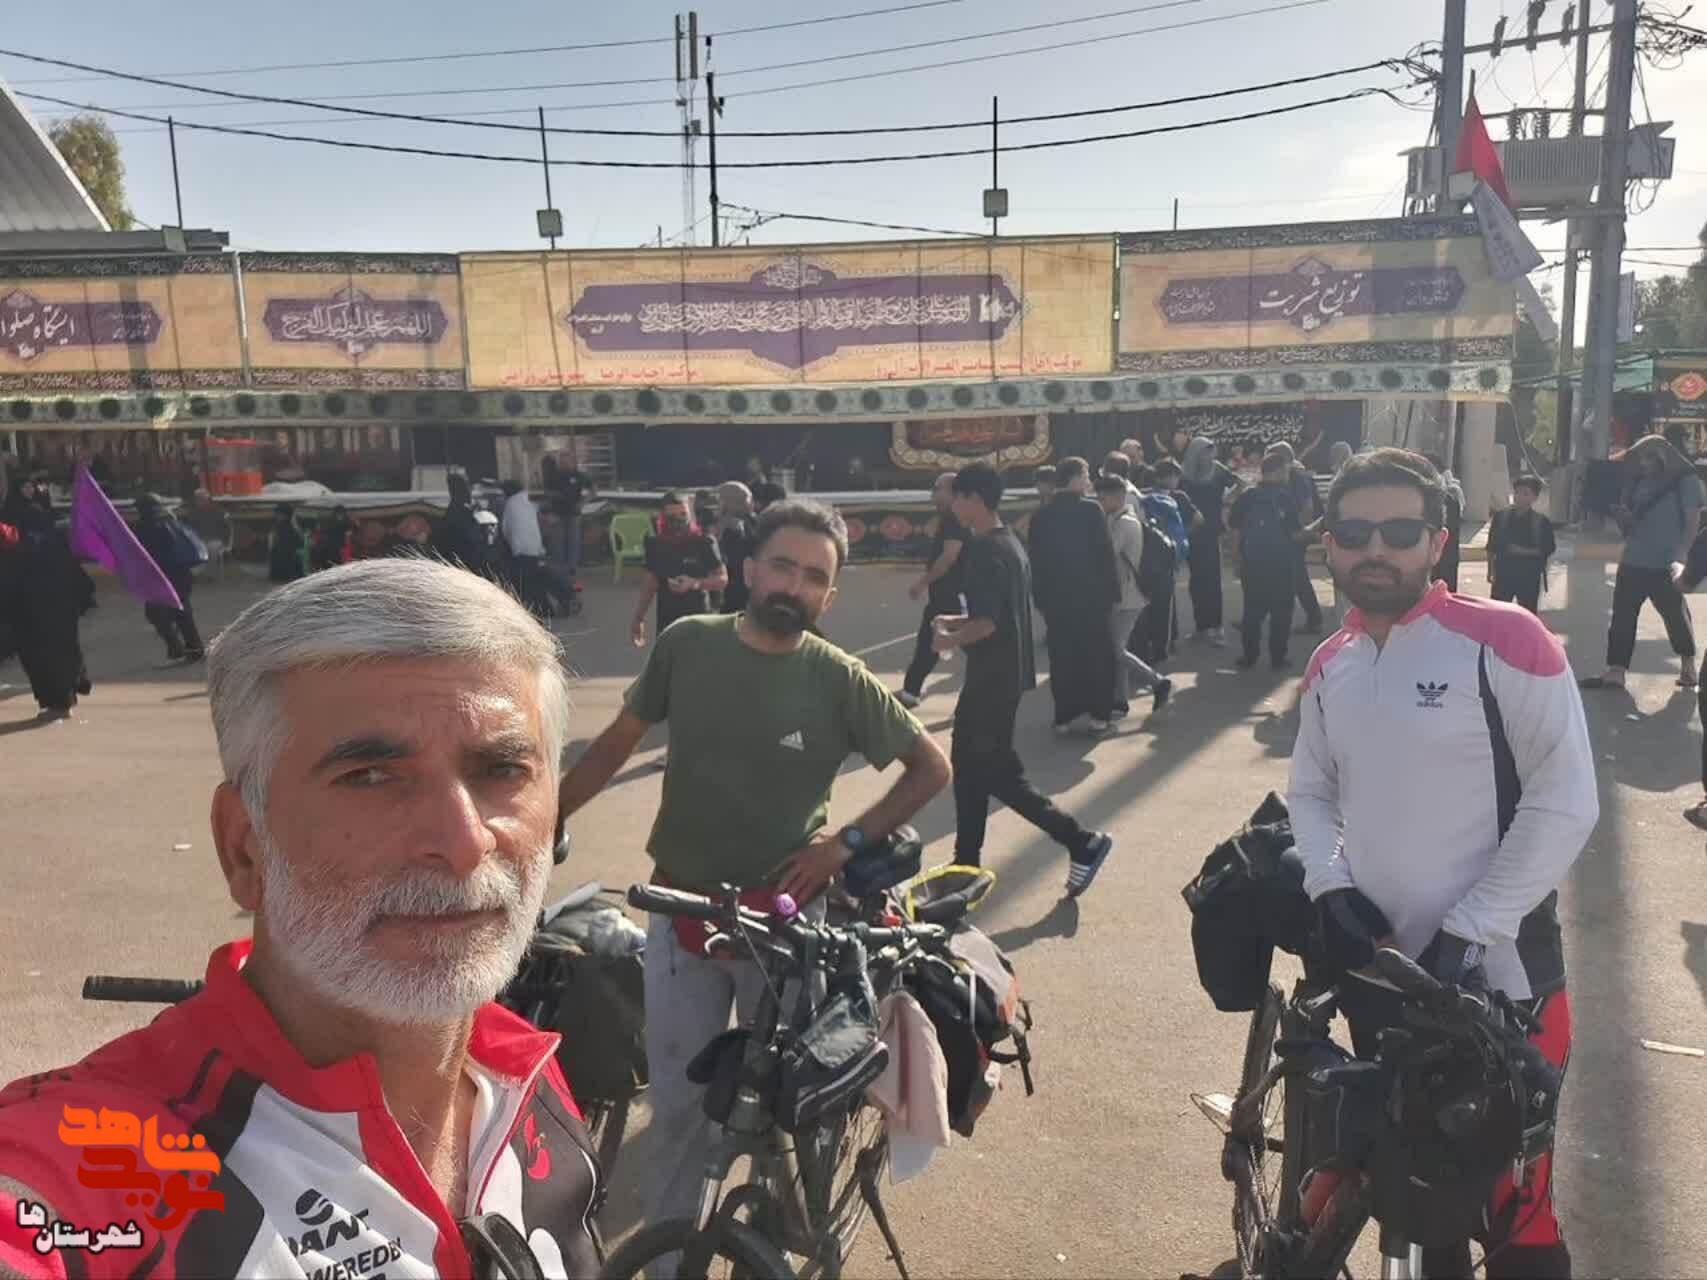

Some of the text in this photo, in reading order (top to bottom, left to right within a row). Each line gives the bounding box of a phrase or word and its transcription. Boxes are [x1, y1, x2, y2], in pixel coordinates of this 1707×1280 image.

[1258, 276, 1321, 317] شربت
[1319, 273, 1363, 318] توزیع
[0, 309, 35, 338] صلوا
